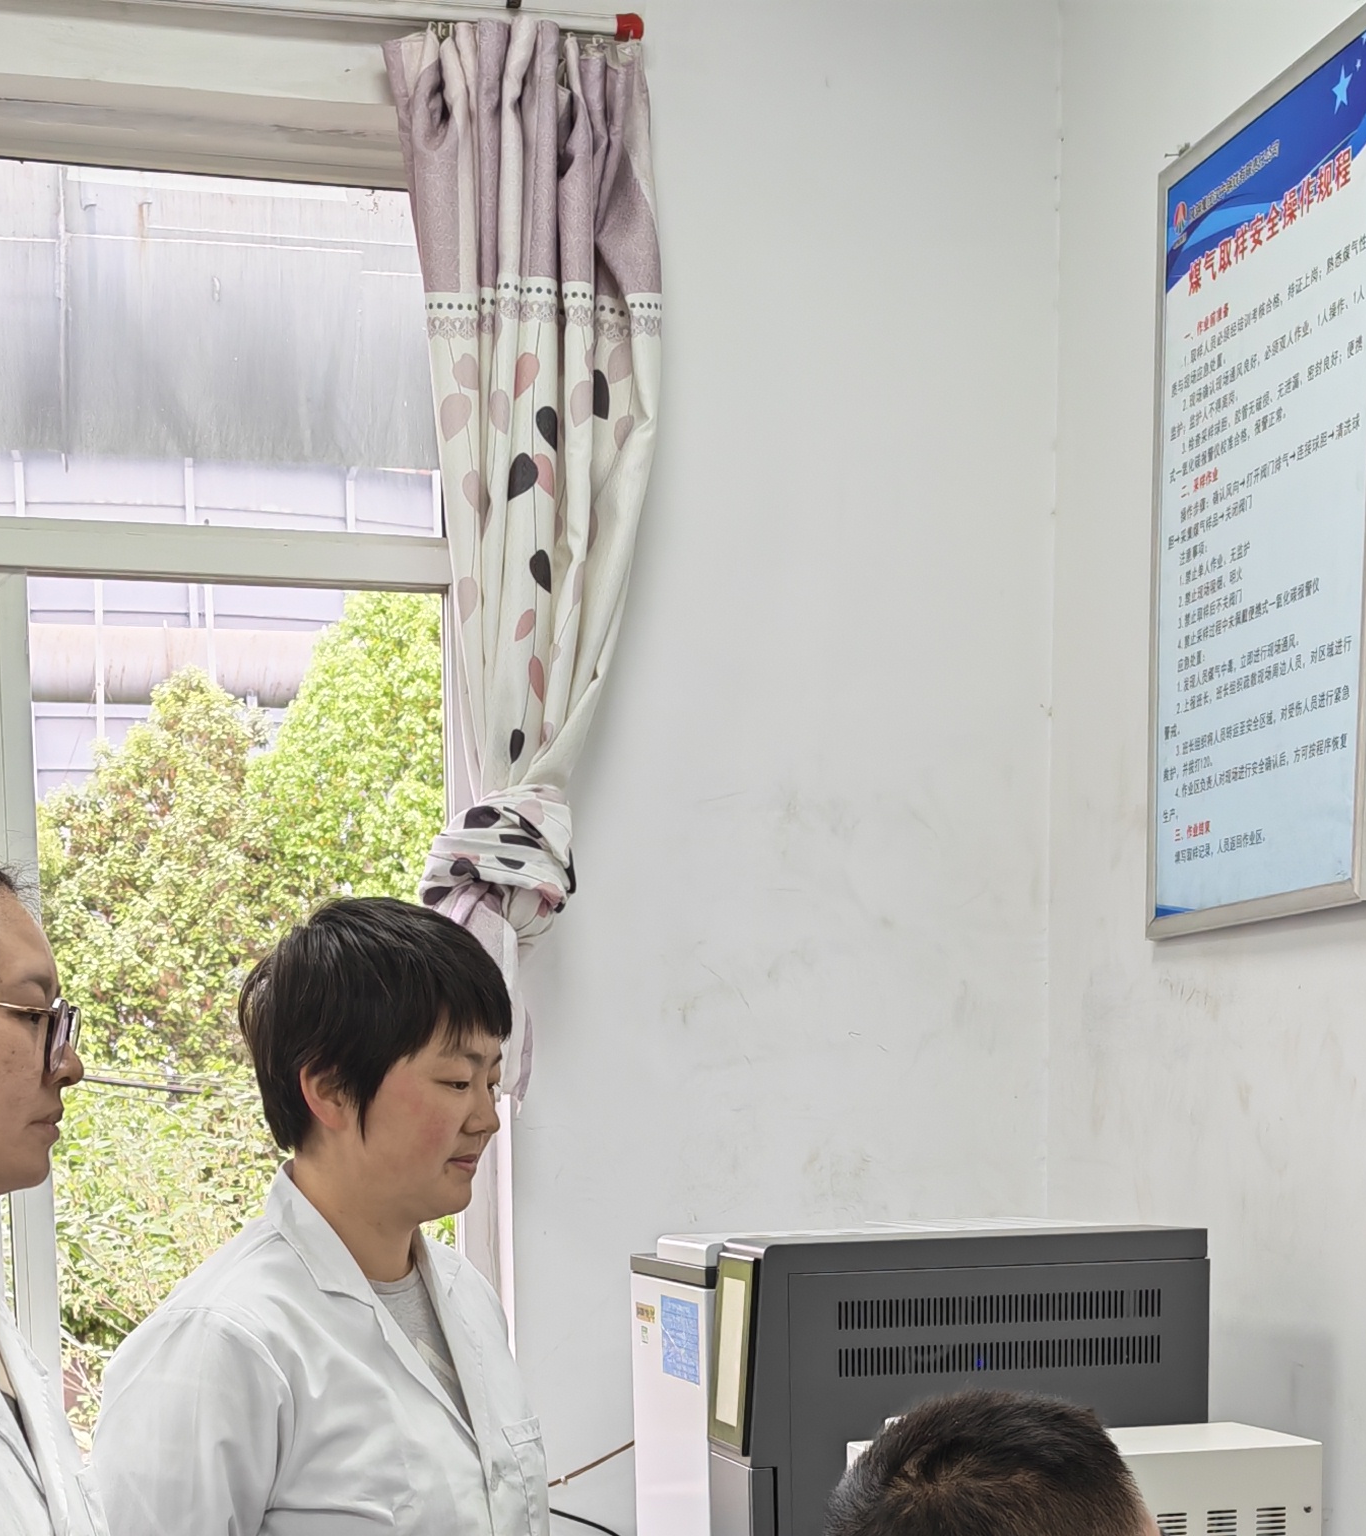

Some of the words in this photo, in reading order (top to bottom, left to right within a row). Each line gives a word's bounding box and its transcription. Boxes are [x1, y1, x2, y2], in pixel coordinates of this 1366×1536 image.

[1188, 147, 1353, 297] 煤气取样安全操作规程
